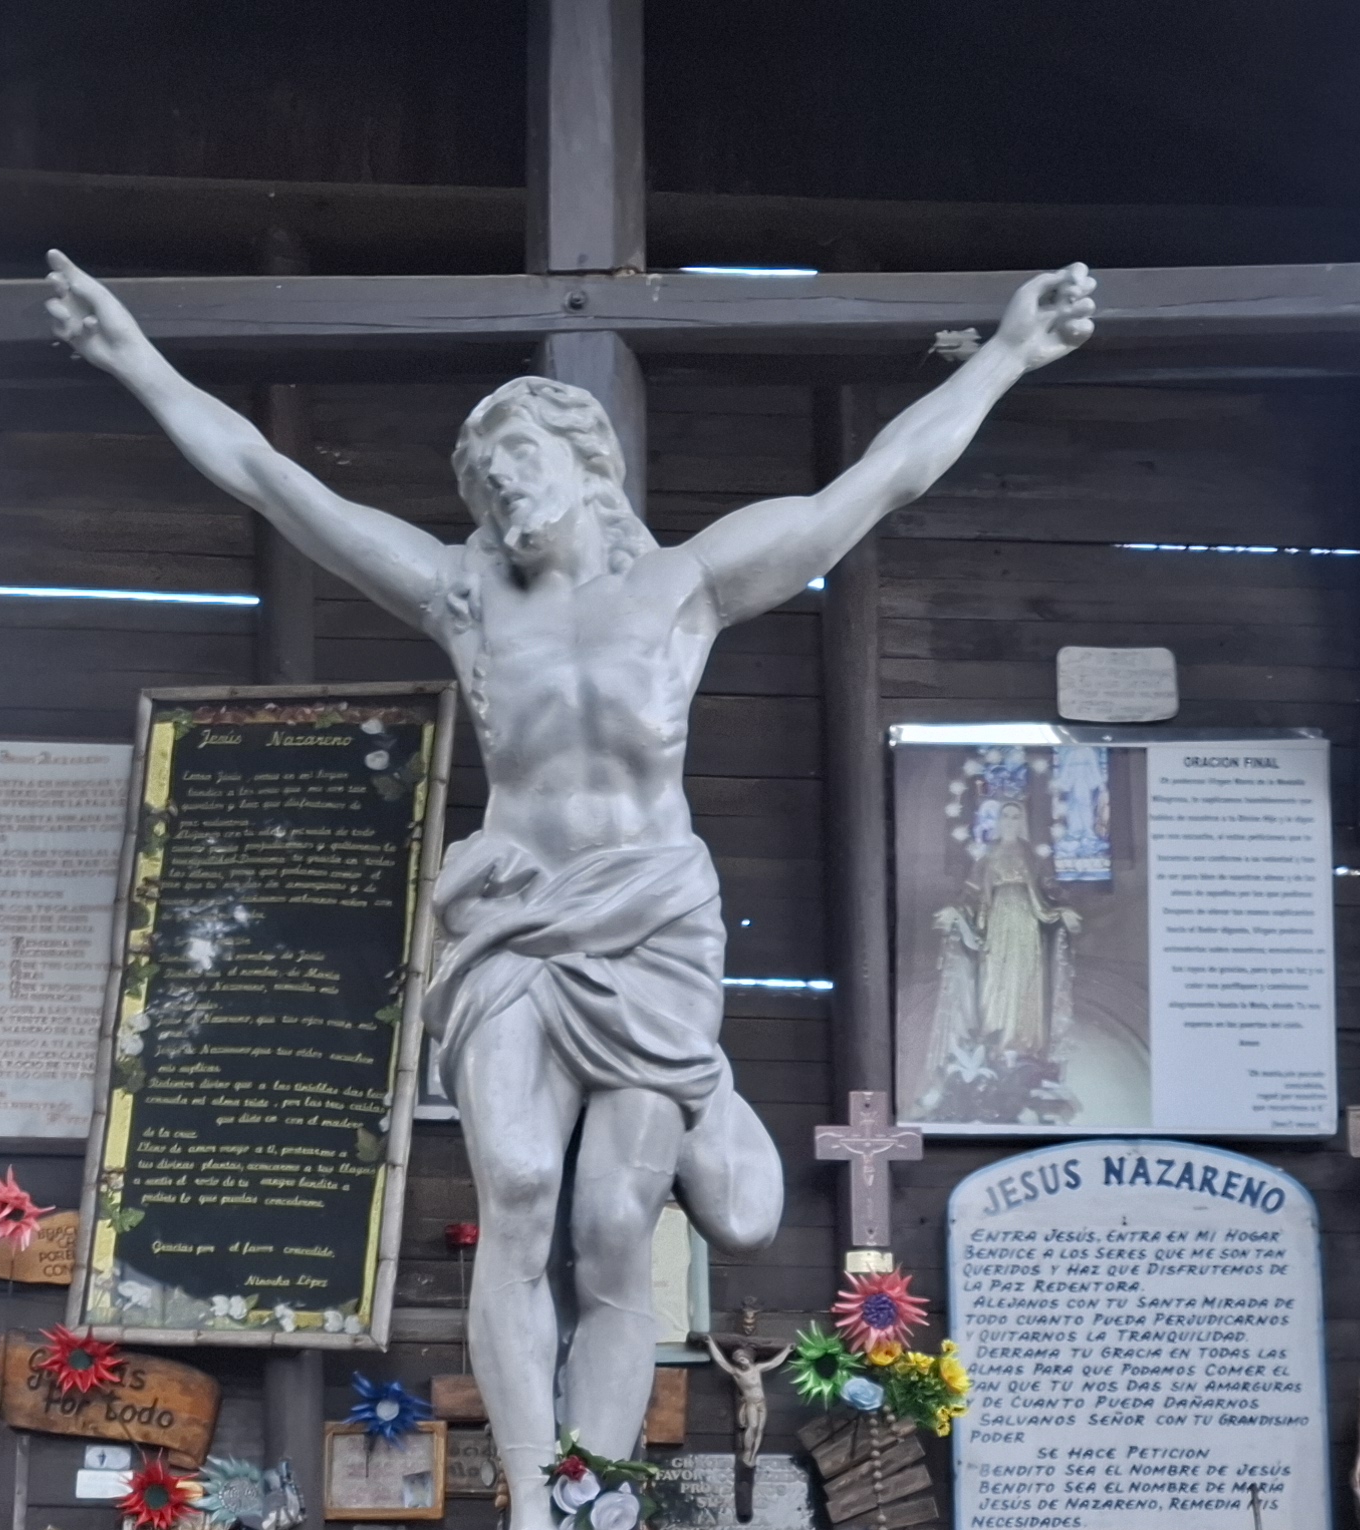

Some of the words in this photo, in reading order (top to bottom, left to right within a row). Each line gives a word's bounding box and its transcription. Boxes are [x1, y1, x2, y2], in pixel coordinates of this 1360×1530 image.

[266, 731, 353, 746] Nazareno
[1183, 757, 1239, 769] ORACION
[1244, 757, 1279, 769] FINAL
[983, 1158, 1081, 1215] JESUS
[1103, 1155, 1286, 1214] NAZARENO
[969, 1228, 1038, 1243] ENTRA
[1105, 1228, 1162, 1243] ENTRA
[1165, 1228, 1189, 1243] EN
[1194, 1228, 1217, 1243] MI
[1223, 1228, 1281, 1243] HOGAR
[1058, 1245, 1090, 1260] LOS
[1094, 1245, 1148, 1260] SERES
[1153, 1245, 1186, 1260] QUE
[1189, 1245, 1215, 1260] ME
[1218, 1245, 1250, 1260] SON
[1254, 1245, 1286, 1260] TAN
[962, 1262, 1042, 1277] QUERIDOS
[1065, 1262, 1101, 1277] HAZ
[1105, 1262, 1140, 1277] QUE
[1145, 1262, 1264, 1277] DISFRUTEMOS
[1268, 1262, 1288, 1277] DE
[963, 1278, 983, 1293] LA
[988, 1278, 1025, 1293] PAZ
[972, 1295, 1060, 1310] ALEJANOS
[1065, 1295, 1100, 1310] CON
[1105, 1295, 1129, 1310] TU
[1136, 1295, 1198, 1310] SANTA
[1200, 1295, 1270, 1310] MIRADA
[1273, 1295, 1295, 1310] DE
[965, 1311, 1009, 1326] TODO
[1015, 1311, 1085, 1326] CUANTO
[1092, 1311, 1147, 1326] PUEDA
[1152, 1311, 1290, 1326] PERJUDICARNOS
[978, 1328, 1078, 1343] QUITARNOS
[1085, 1328, 1108, 1343] LA
[975, 1345, 1061, 1360] DERRAMA
[1070, 1345, 1094, 1360] TU
[1099, 1345, 1163, 1360] GRACIA
[1168, 1345, 1192, 1360] EN
[1198, 1345, 1251, 1360] TODAS
[1256, 1345, 1288, 1360] LAS
[967, 1362, 1025, 1377] ALMAS
[1032, 1362, 1074, 1377] PARA
[1081, 1362, 1114, 1377] QUE
[1120, 1362, 1196, 1377] PODAMOS
[1203, 1362, 1267, 1377] COMER
[1271, 1362, 1289, 1377] EL
[967, 1378, 1001, 1393] PAN
[1006, 1378, 1041, 1393] QUE
[1049, 1378, 1074, 1393] TU
[1081, 1378, 1119, 1393] NOS
[1125, 1378, 1163, 1393] DAS
[1170, 1378, 1198, 1393] SIN
[1203, 1378, 1303, 1393] AMARGURAS
[104, 1390, 175, 1429] todo
[981, 1395, 1003, 1410] DE
[1009, 1395, 1086, 1410] CUANTO
[1094, 1395, 1156, 1410] PUEDA
[979, 1412, 1077, 1427] SALVANOS
[1155, 1412, 1188, 1427] CON
[1193, 1412, 1214, 1427] TU
[969, 1429, 1026, 1444] PODER
[1036, 1445, 1059, 1460] SE
[1066, 1445, 1117, 1460] HACE
[1125, 1445, 1211, 1460] PETICION
[978, 1462, 1056, 1477] BENDITO
[1064, 1462, 1097, 1477] SEA
[1103, 1462, 1122, 1477] EL
[1128, 1462, 1200, 1477] NOMBRE
[1205, 1462, 1228, 1477] DE
[978, 1479, 1056, 1494] BENDITO
[1063, 1479, 1098, 1494] SEA
[1103, 1479, 1124, 1494] EL
[1127, 1479, 1200, 1494] NOMBRE
[1204, 1479, 1226, 1494] DE
[1036, 1497, 1059, 1512] DE
[1167, 1497, 1242, 1512] REMEDIA
